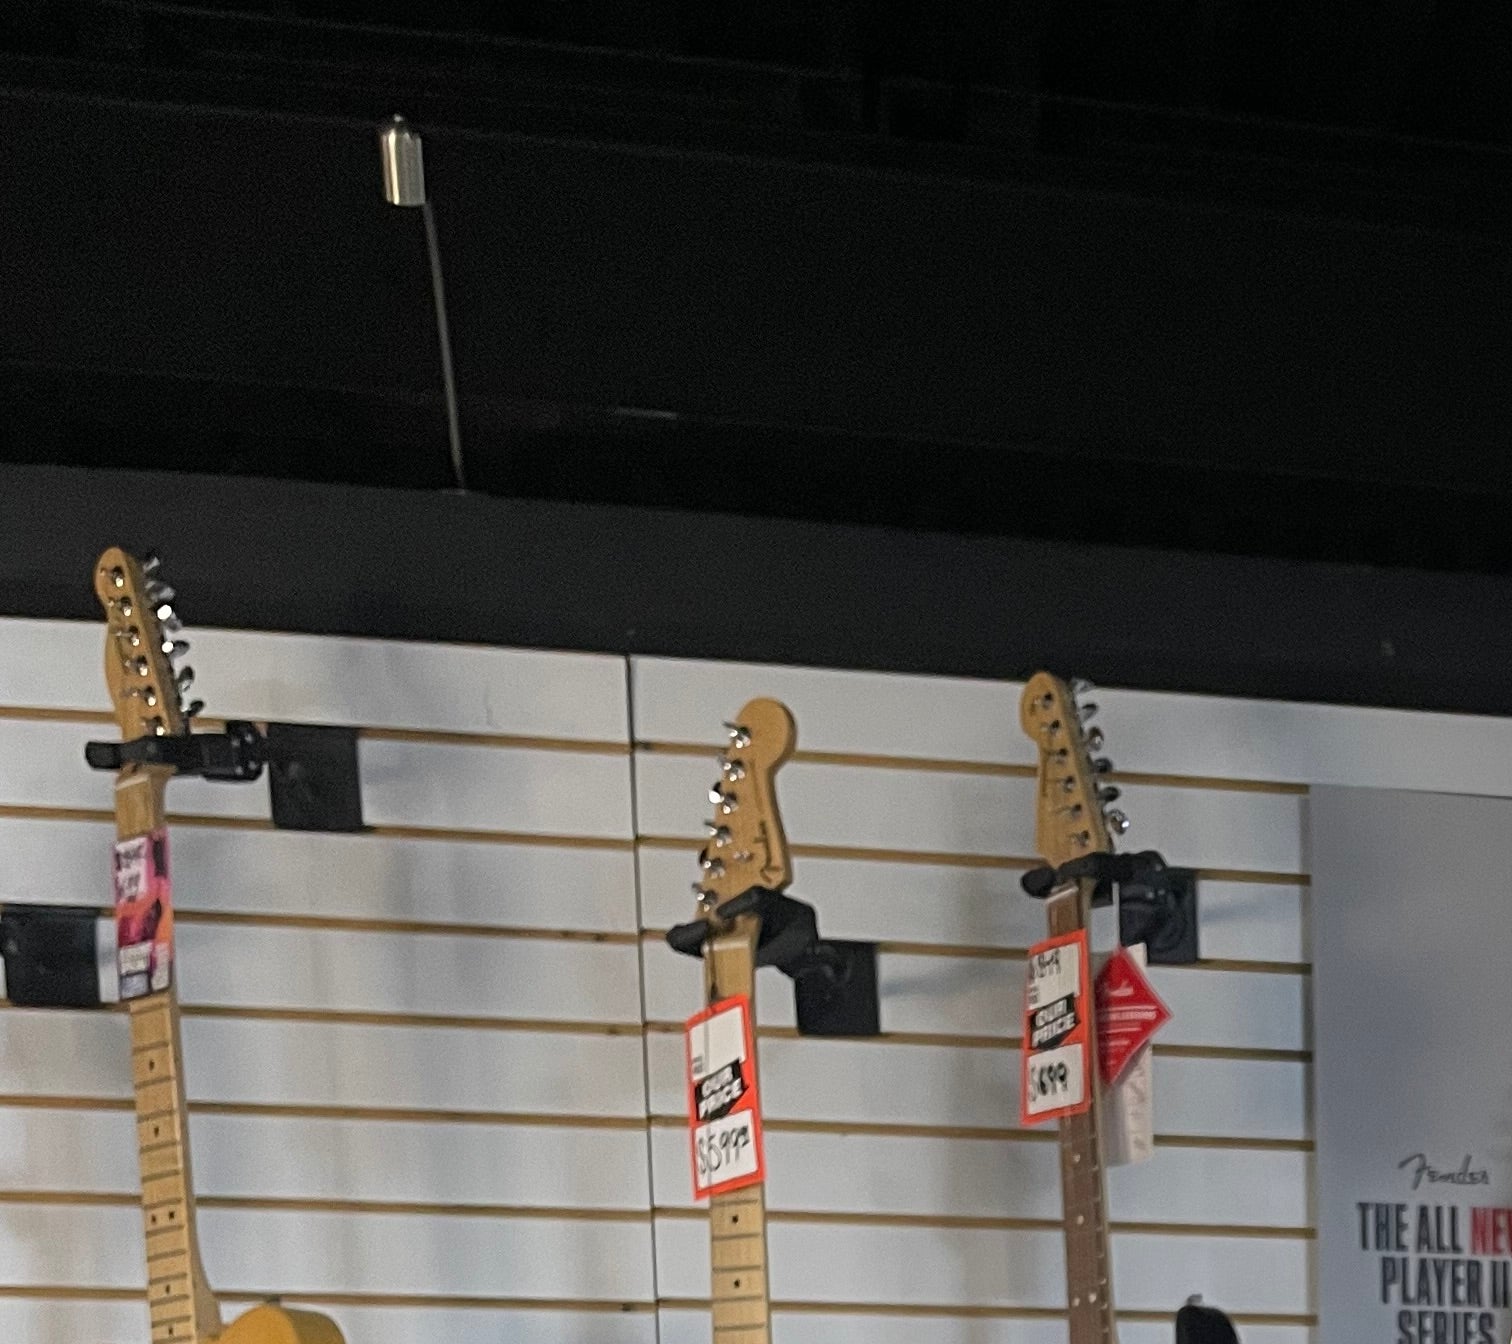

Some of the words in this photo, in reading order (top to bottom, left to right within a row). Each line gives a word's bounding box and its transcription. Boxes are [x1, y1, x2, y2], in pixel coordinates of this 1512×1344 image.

[1398, 1152, 1490, 1191] Fender
[1357, 1202, 1408, 1251] THE
[1417, 1205, 1463, 1255] ALL
[1381, 1256, 1483, 1307] PLAYER
[1491, 1260, 1510, 1309] II
